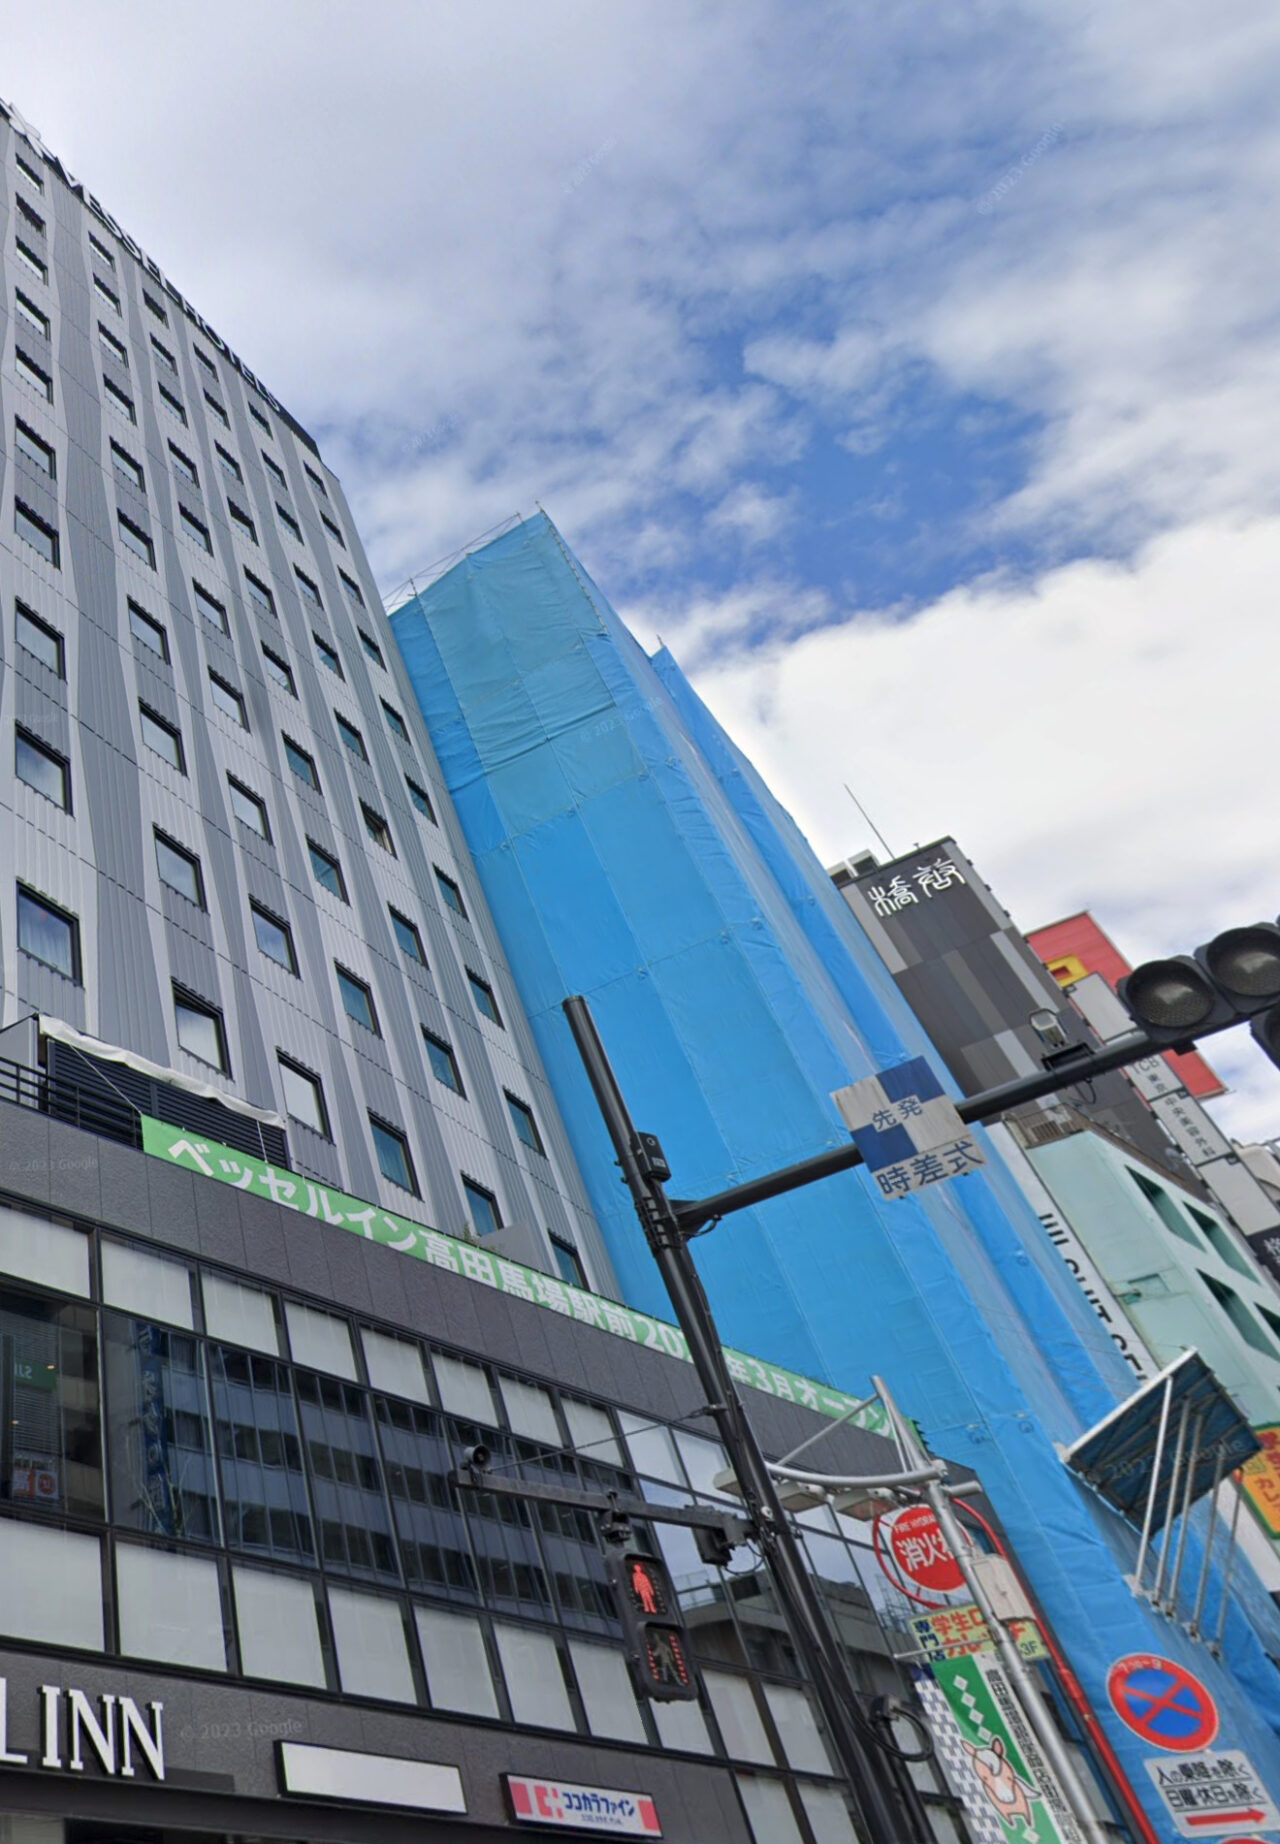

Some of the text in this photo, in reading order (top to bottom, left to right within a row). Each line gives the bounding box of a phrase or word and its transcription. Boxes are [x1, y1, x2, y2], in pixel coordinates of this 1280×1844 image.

[872, 1094, 924, 1132] 先発
[877, 1141, 985, 1196] 時差式
[1020, 1640, 1038, 1656] 3F
[38, 1684, 165, 1781] INN
[562, 1791, 635, 1817] ココカラファイン
